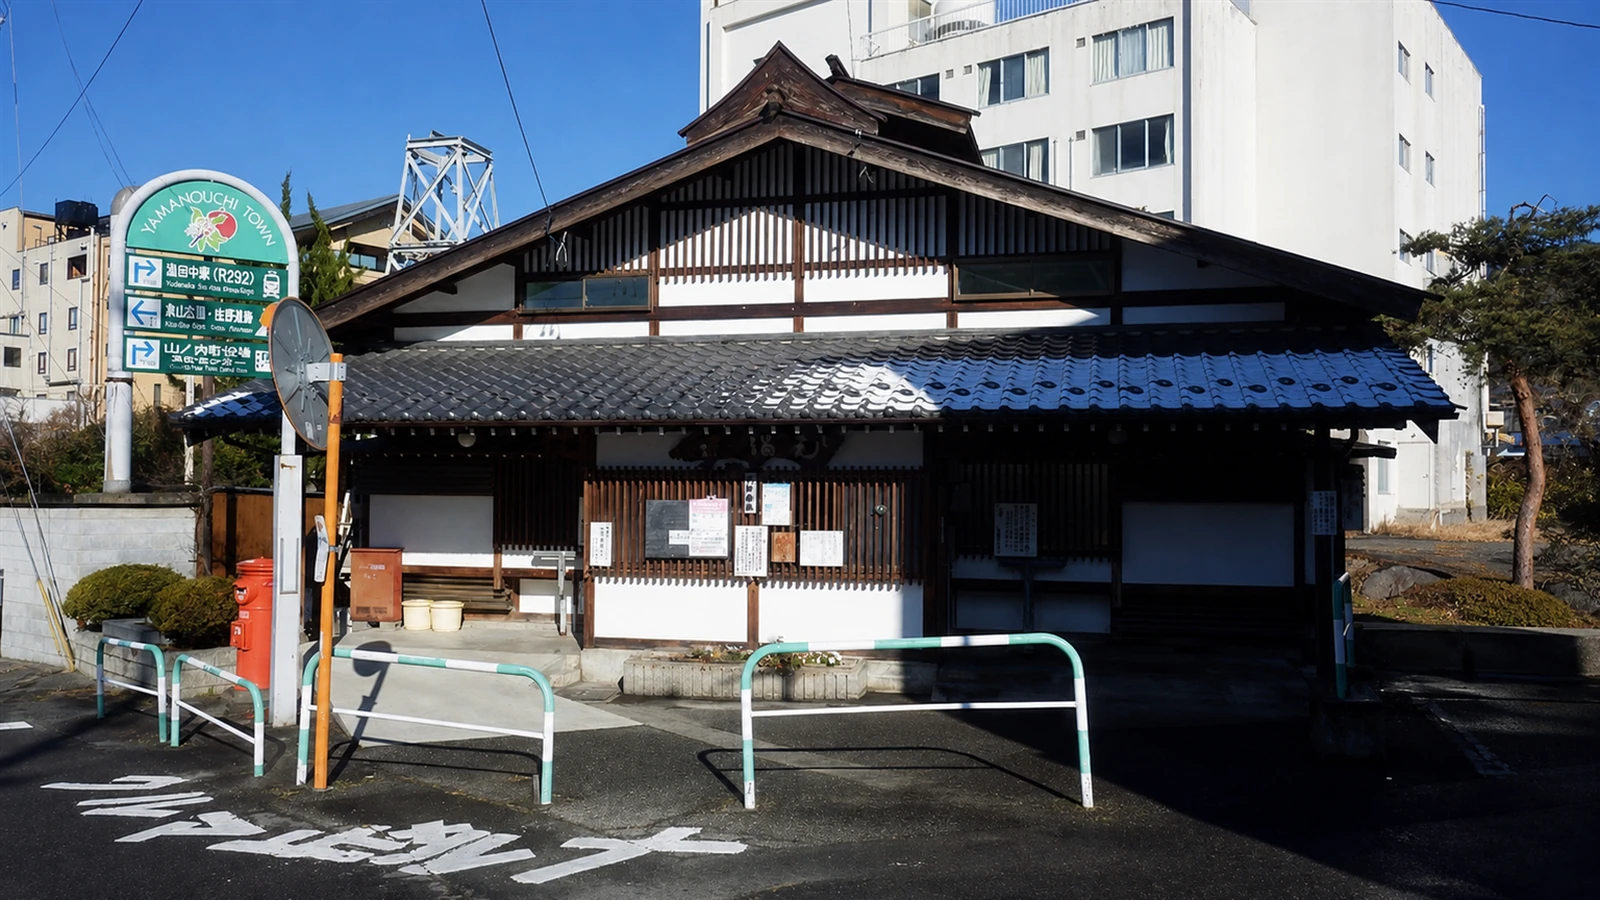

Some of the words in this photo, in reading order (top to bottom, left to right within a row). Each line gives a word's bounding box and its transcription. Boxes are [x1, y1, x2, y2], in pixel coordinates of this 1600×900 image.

[140, 190, 239, 234] YAMANOUCHI
[243, 205, 277, 247] TOWN
[213, 267, 255, 285] (R292)
